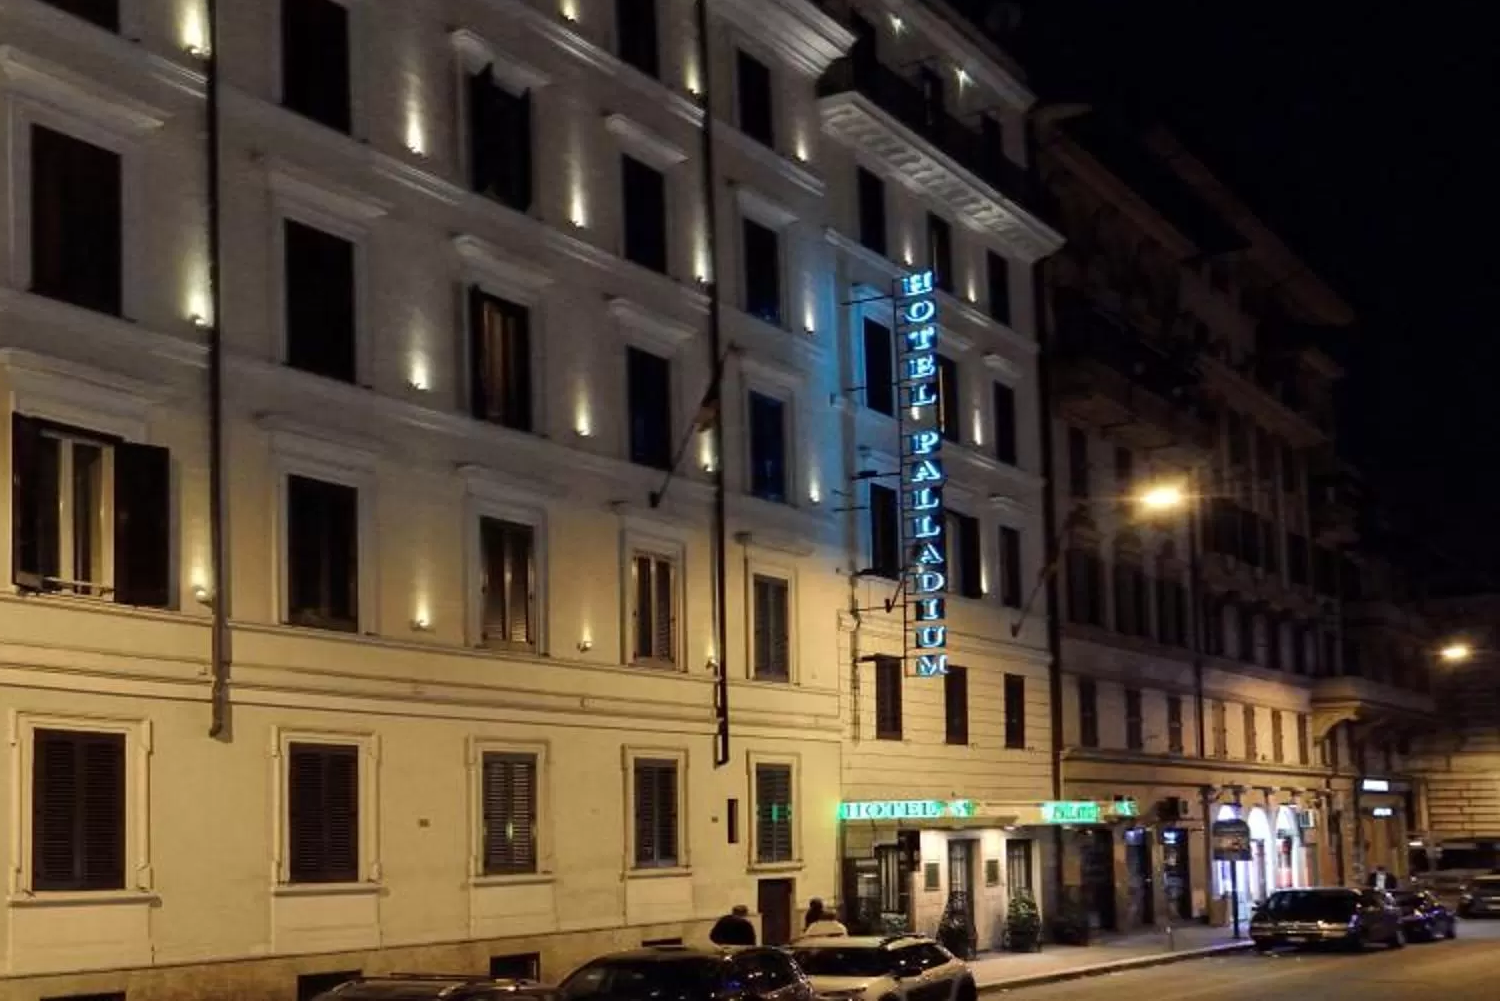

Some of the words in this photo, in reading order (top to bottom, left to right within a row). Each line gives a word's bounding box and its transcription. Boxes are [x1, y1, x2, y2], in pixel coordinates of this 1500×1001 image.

[902, 270, 937, 406] HOTEL
[911, 431, 949, 676] PALLADIUM
[845, 802, 938, 817] HOTEL
